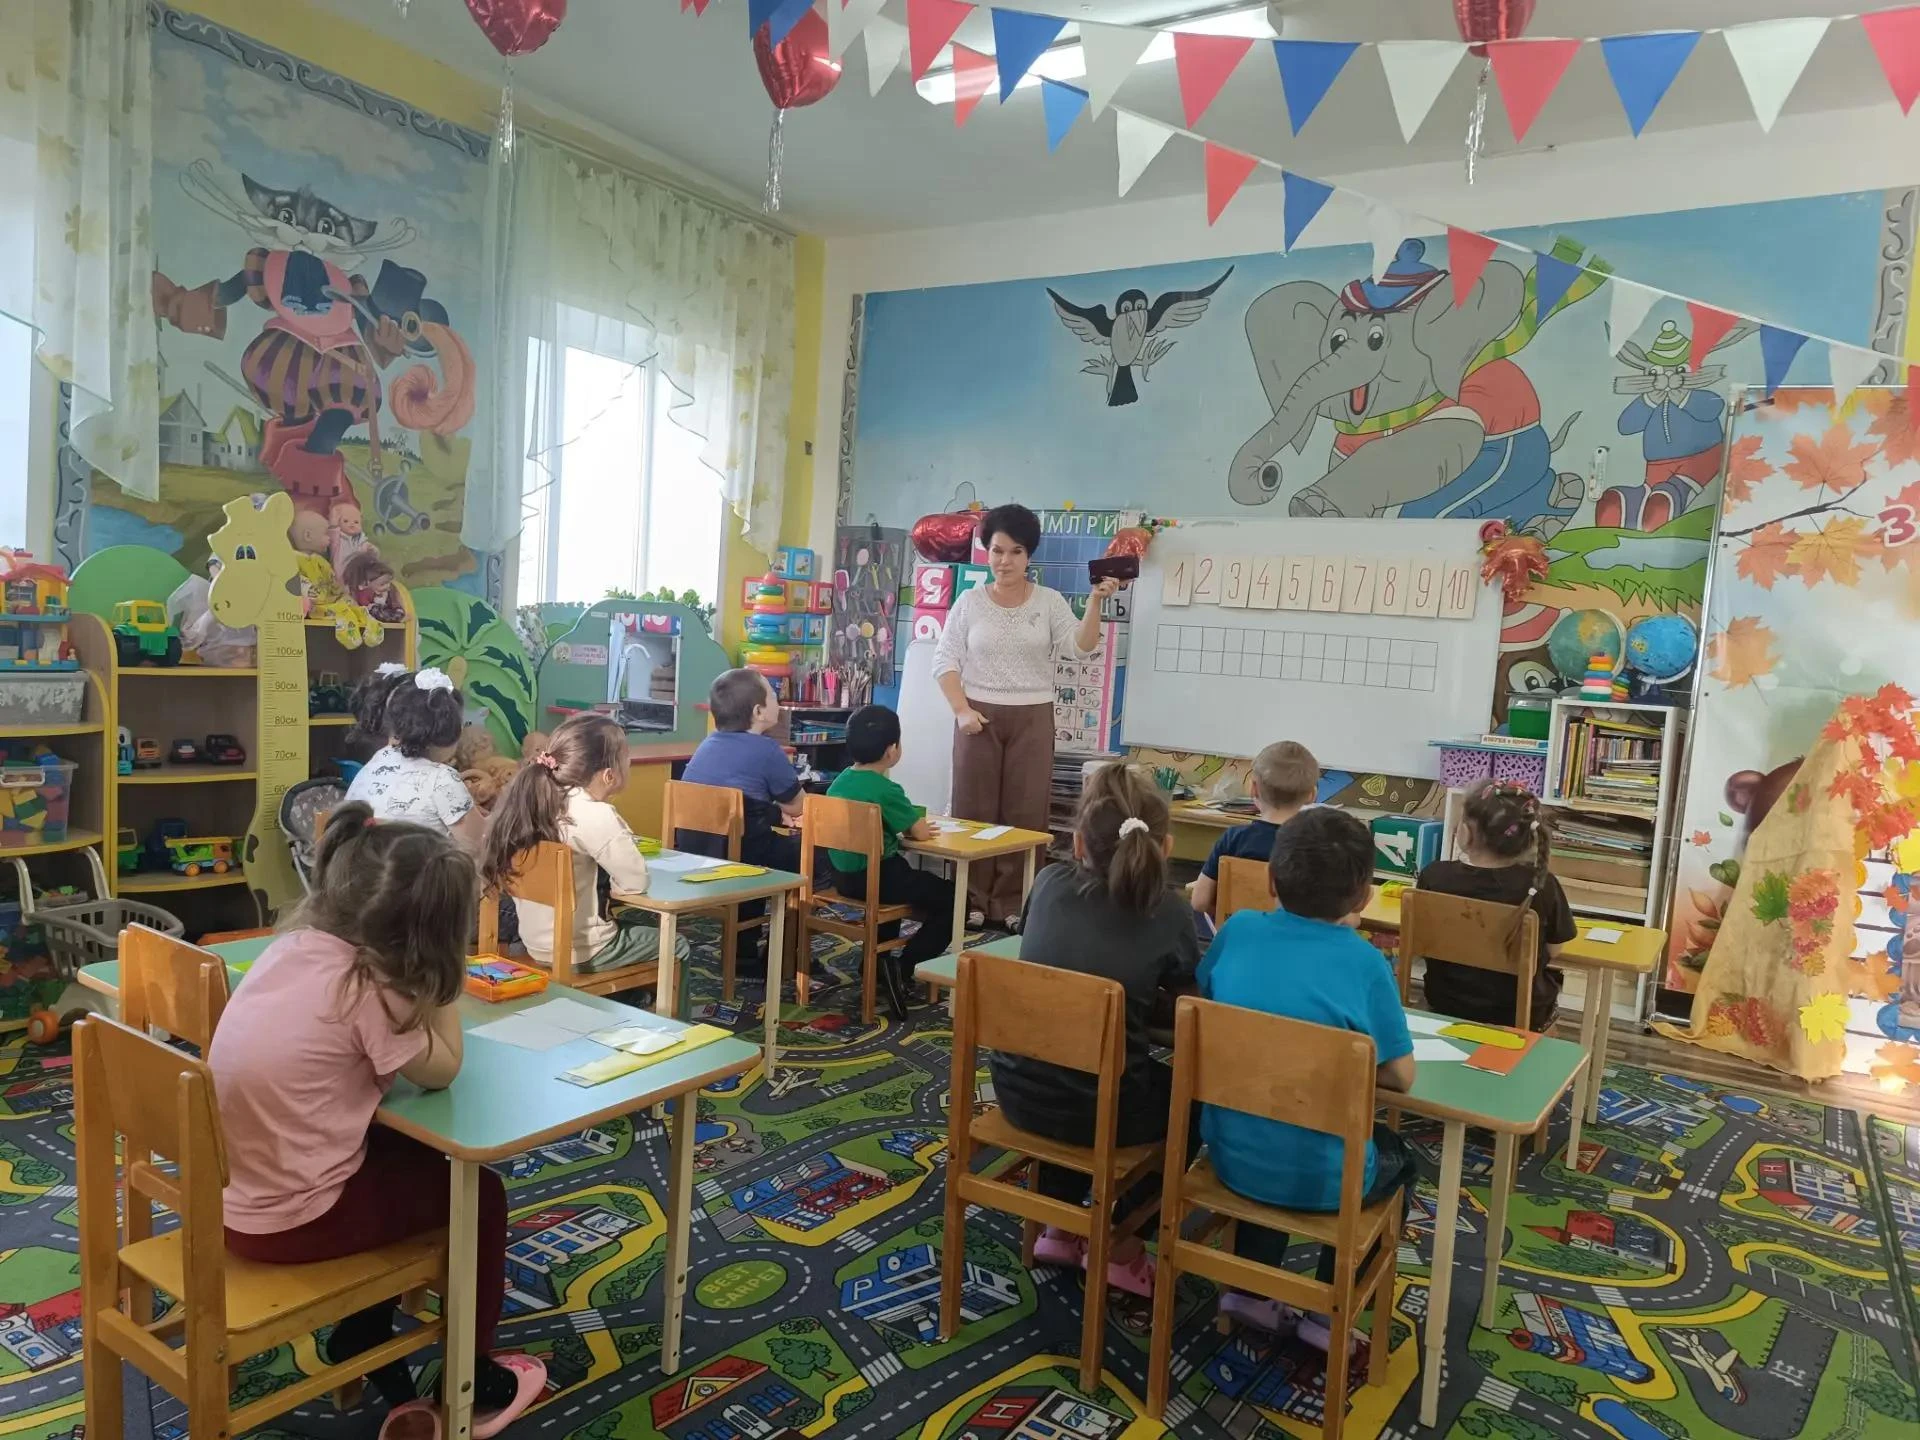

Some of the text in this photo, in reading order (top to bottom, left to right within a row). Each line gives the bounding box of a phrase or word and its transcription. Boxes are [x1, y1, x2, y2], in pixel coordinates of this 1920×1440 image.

[1175, 560, 1184, 597] 1
[1194, 558, 1213, 594] 2
[1228, 562, 1242, 599] 3
[1256, 562, 1270, 600] 4
[1288, 564, 1302, 600] 5
[1321, 565, 1334, 603] 6
[1353, 565, 1367, 605] 7
[1383, 566, 1397, 606] 8
[1447, 569, 1470, 609] 10
[1081, 666, 1088, 675] К
[1374, 831, 1414, 867] 4
[703, 1266, 749, 1293] BEST
[713, 1267, 782, 1308] CARPET
[853, 1278, 873, 1300] P
[1400, 1287, 1429, 1315] BUS
[982, 1403, 1024, 1419] H
